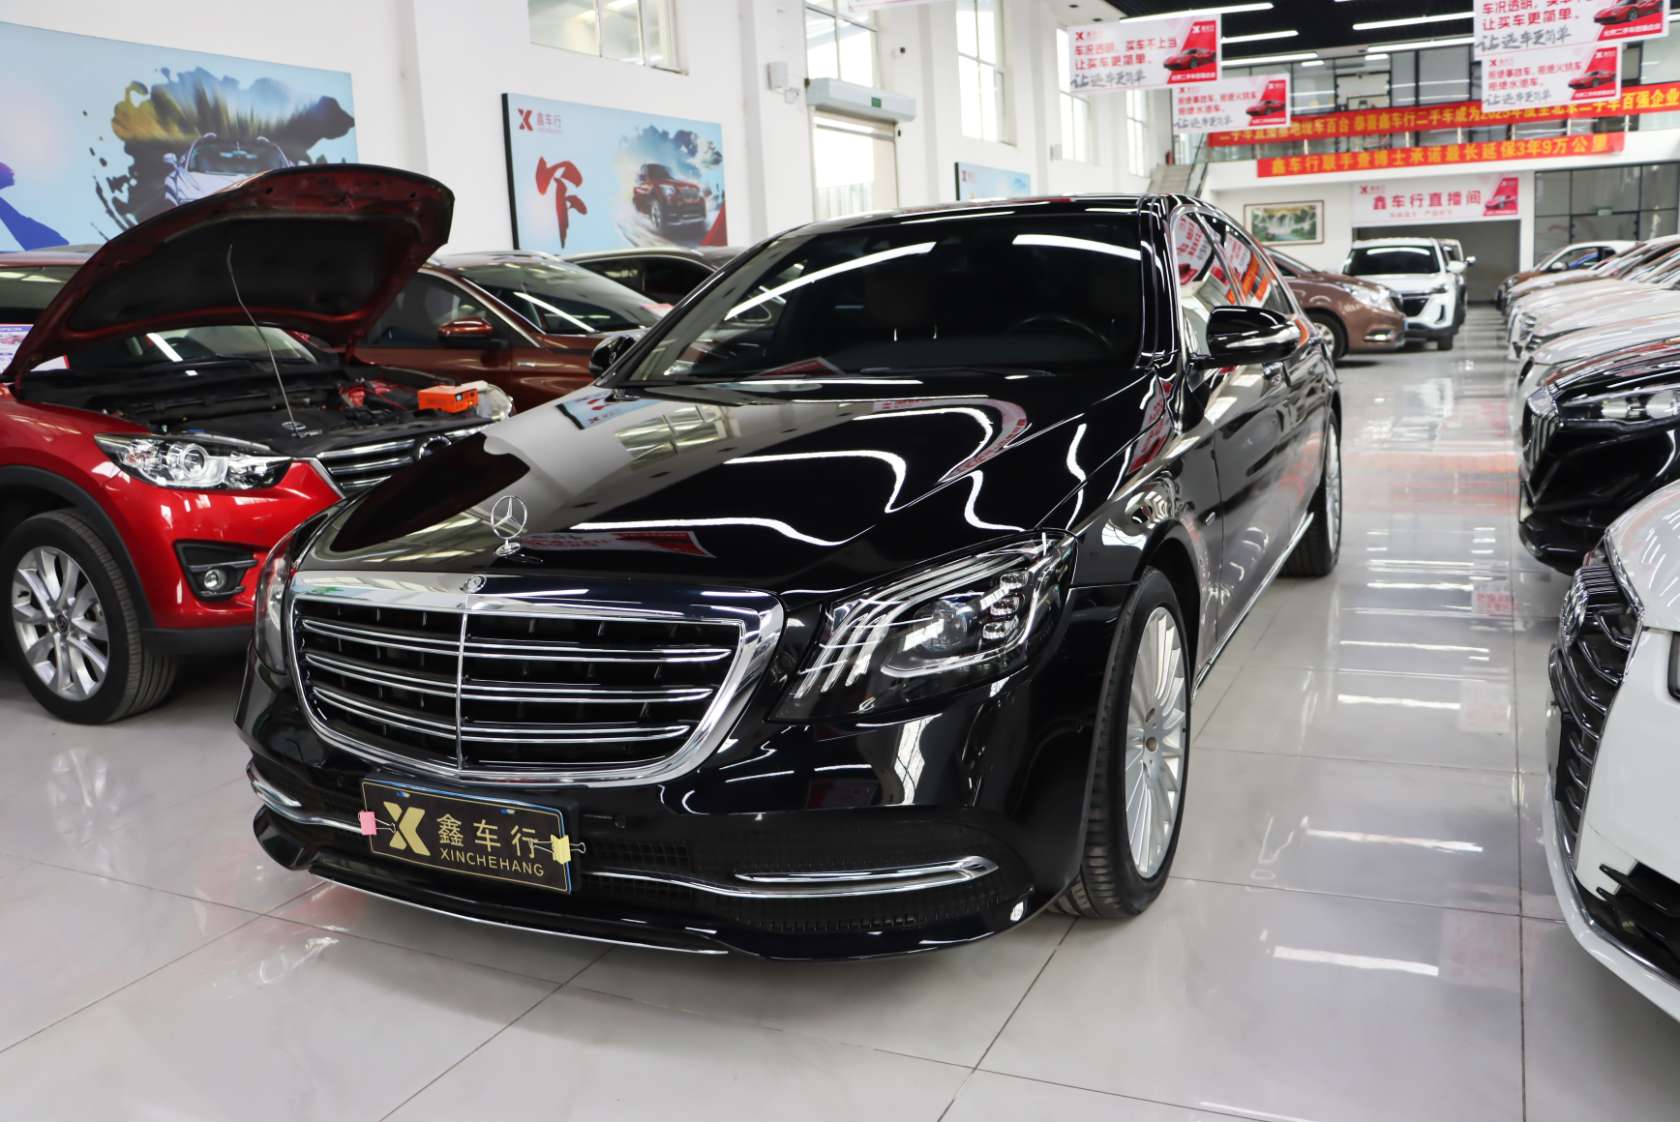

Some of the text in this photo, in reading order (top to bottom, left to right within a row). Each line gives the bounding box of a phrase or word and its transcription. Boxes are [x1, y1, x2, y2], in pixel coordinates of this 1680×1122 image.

[1373, 190, 1481, 210] 鑫车行直播间
[436, 813, 538, 859] 鑫车行
[440, 848, 545, 877] XINCHEHANG
